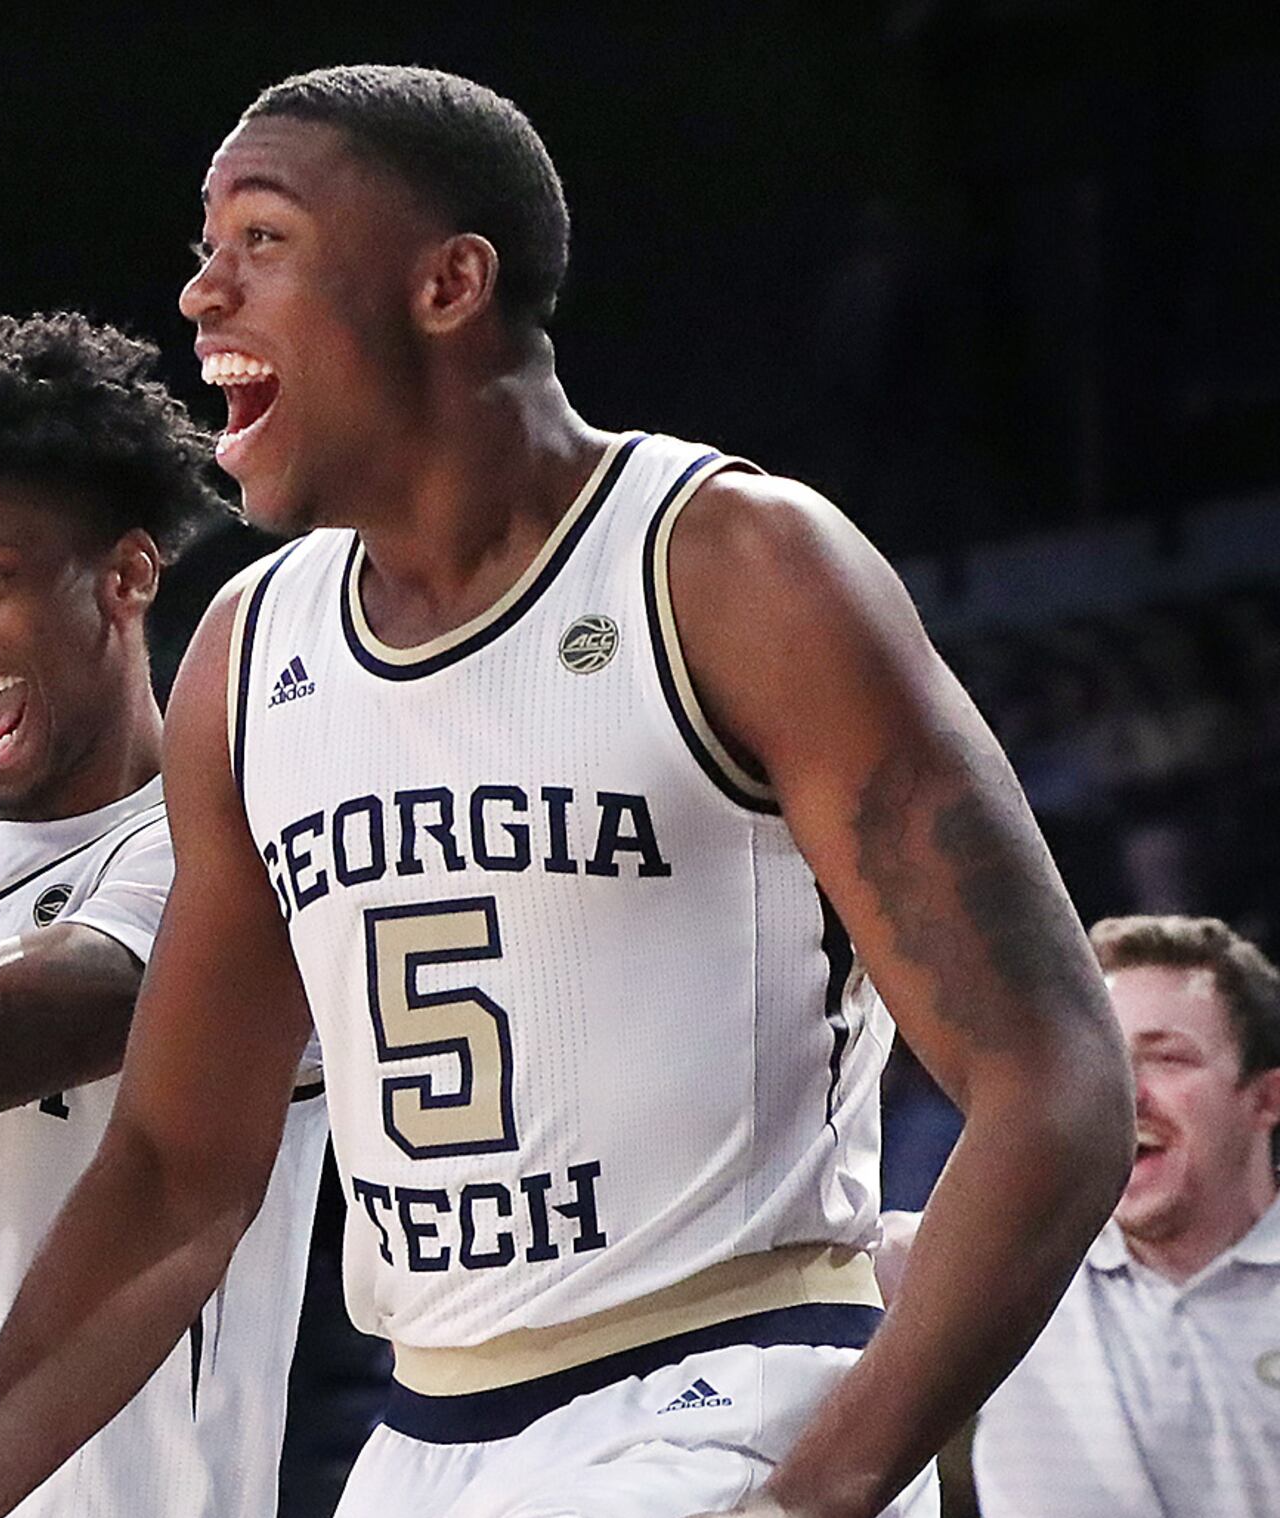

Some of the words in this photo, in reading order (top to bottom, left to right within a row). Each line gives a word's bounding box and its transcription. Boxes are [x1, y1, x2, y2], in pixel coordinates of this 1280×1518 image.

[565, 634, 614, 650] ACC
[267, 681, 316, 709] adidas
[363, 896, 520, 1160] 5
[352, 1160, 608, 1273] TECH
[656, 1396, 733, 1415] adidas
